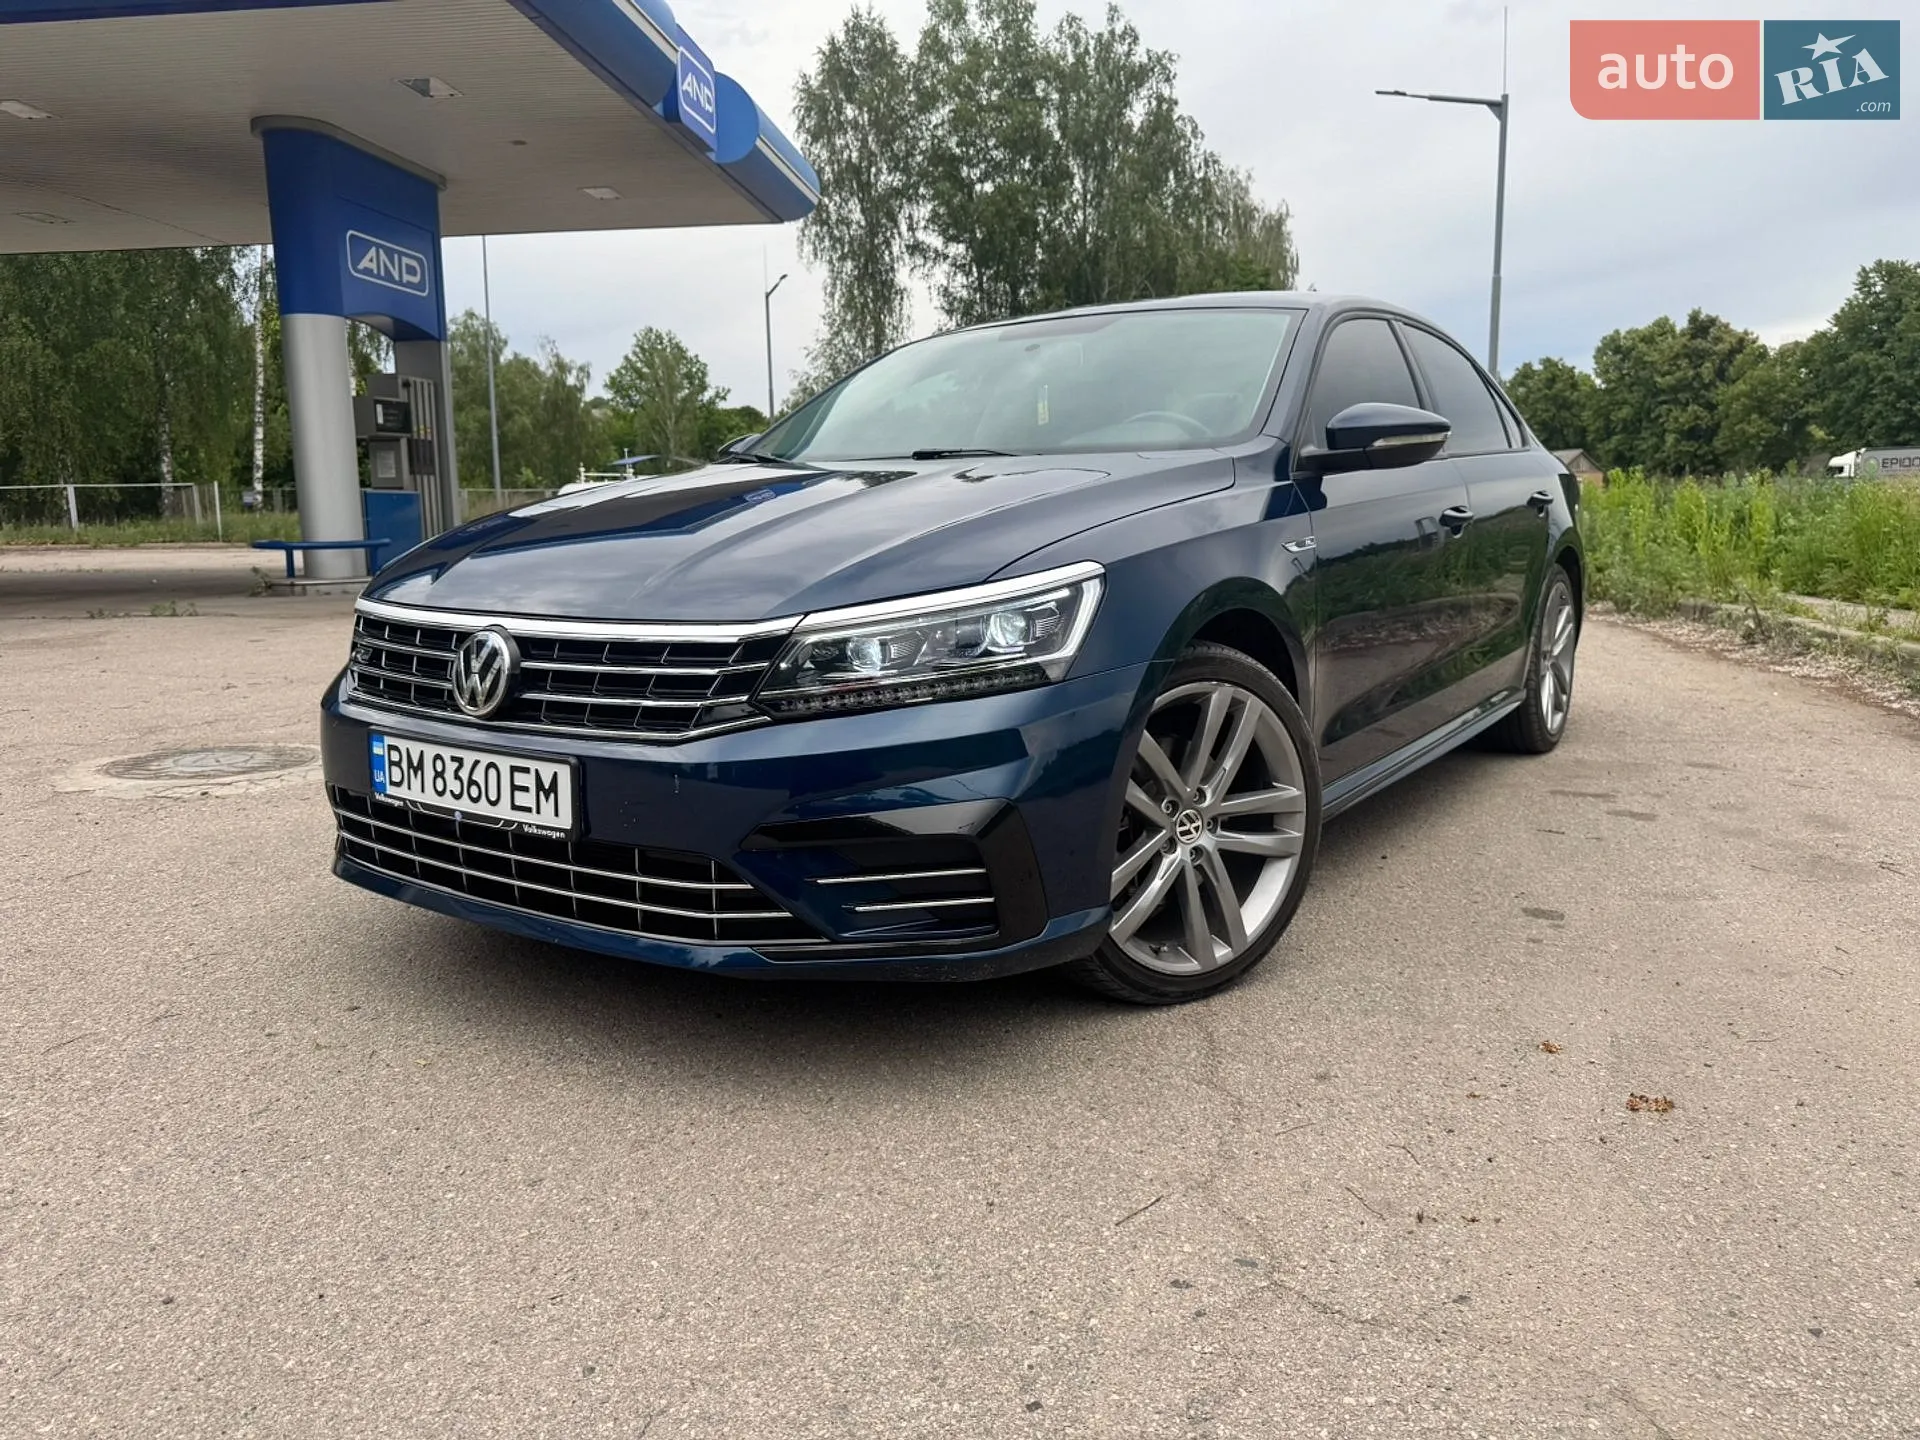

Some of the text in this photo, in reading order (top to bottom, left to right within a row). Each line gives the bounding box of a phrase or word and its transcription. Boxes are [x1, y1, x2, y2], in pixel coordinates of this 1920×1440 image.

[387, 743, 560, 818] BM 8360 EM
[522, 823, 566, 839] Volkswagen
